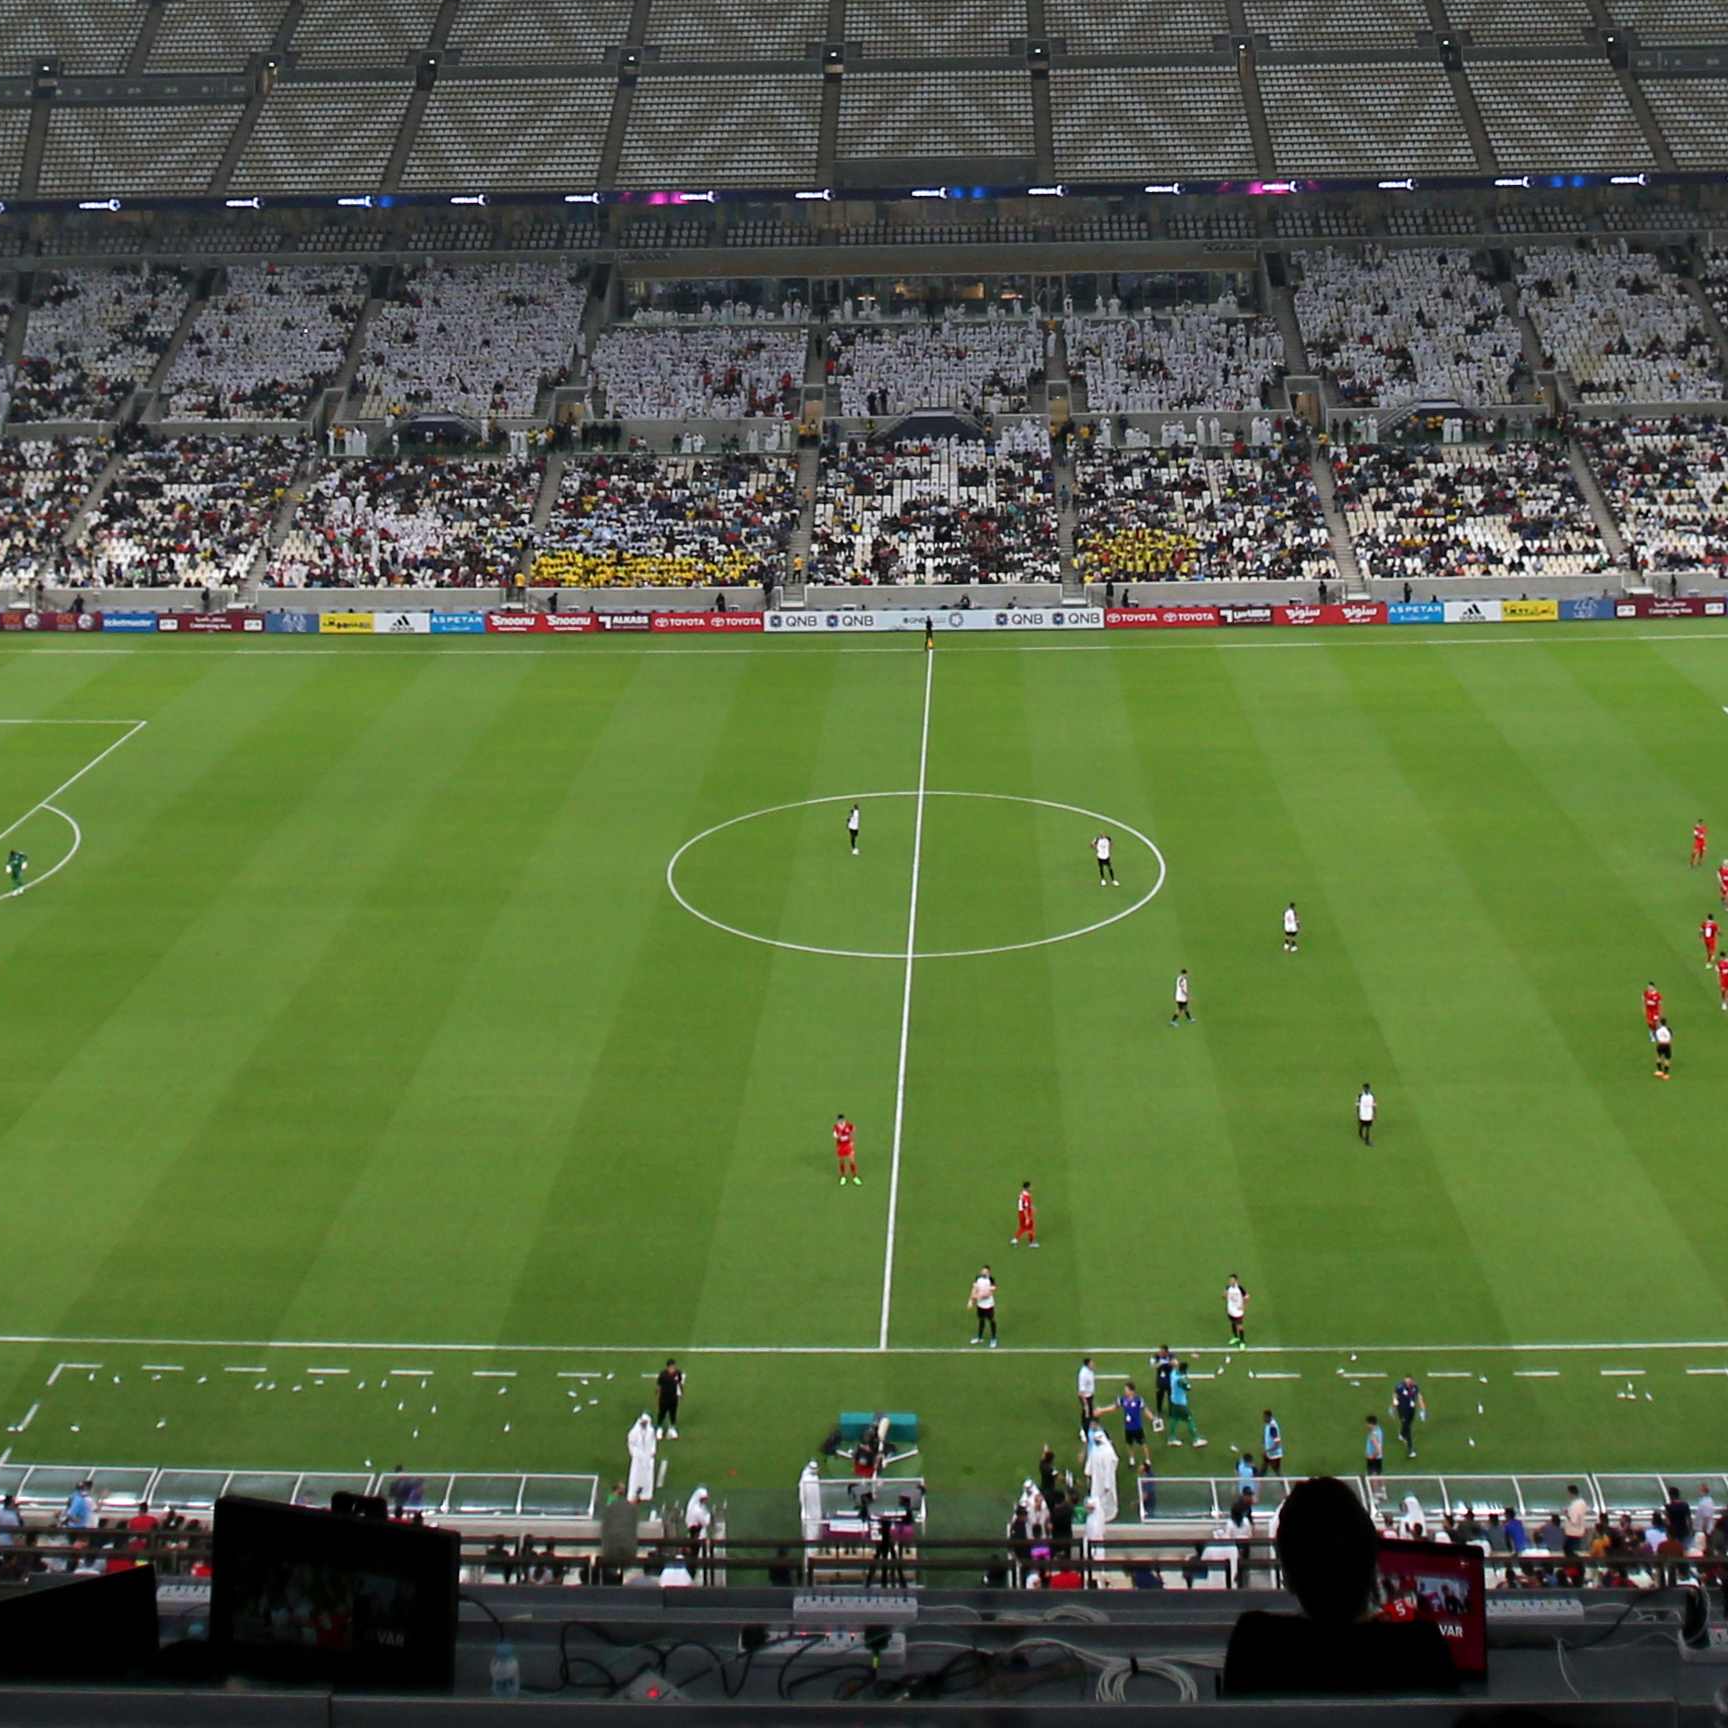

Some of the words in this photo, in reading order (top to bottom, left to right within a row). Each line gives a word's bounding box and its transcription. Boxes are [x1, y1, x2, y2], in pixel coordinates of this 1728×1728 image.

[1389, 605, 1441, 613] ASPETAR
[431, 616, 482, 624] ASPETAR
[489, 614, 535, 626] Snoonu
[545, 614, 591, 626] Snoonu
[613, 615, 649, 624] ALKASS
[670, 618, 705, 626] TOYOTA
[726, 618, 761, 626] TOYOTA
[785, 615, 818, 627] QNB
[842, 615, 874, 626] QNB
[1011, 613, 1043, 625] QNB
[1068, 613, 1101, 624] QNB
[1122, 613, 1157, 622] TOYOTA
[1178, 613, 1214, 621] TOYOTA
[1438, 1623, 1464, 1638] VAR
[376, 1631, 405, 1647] VAR
